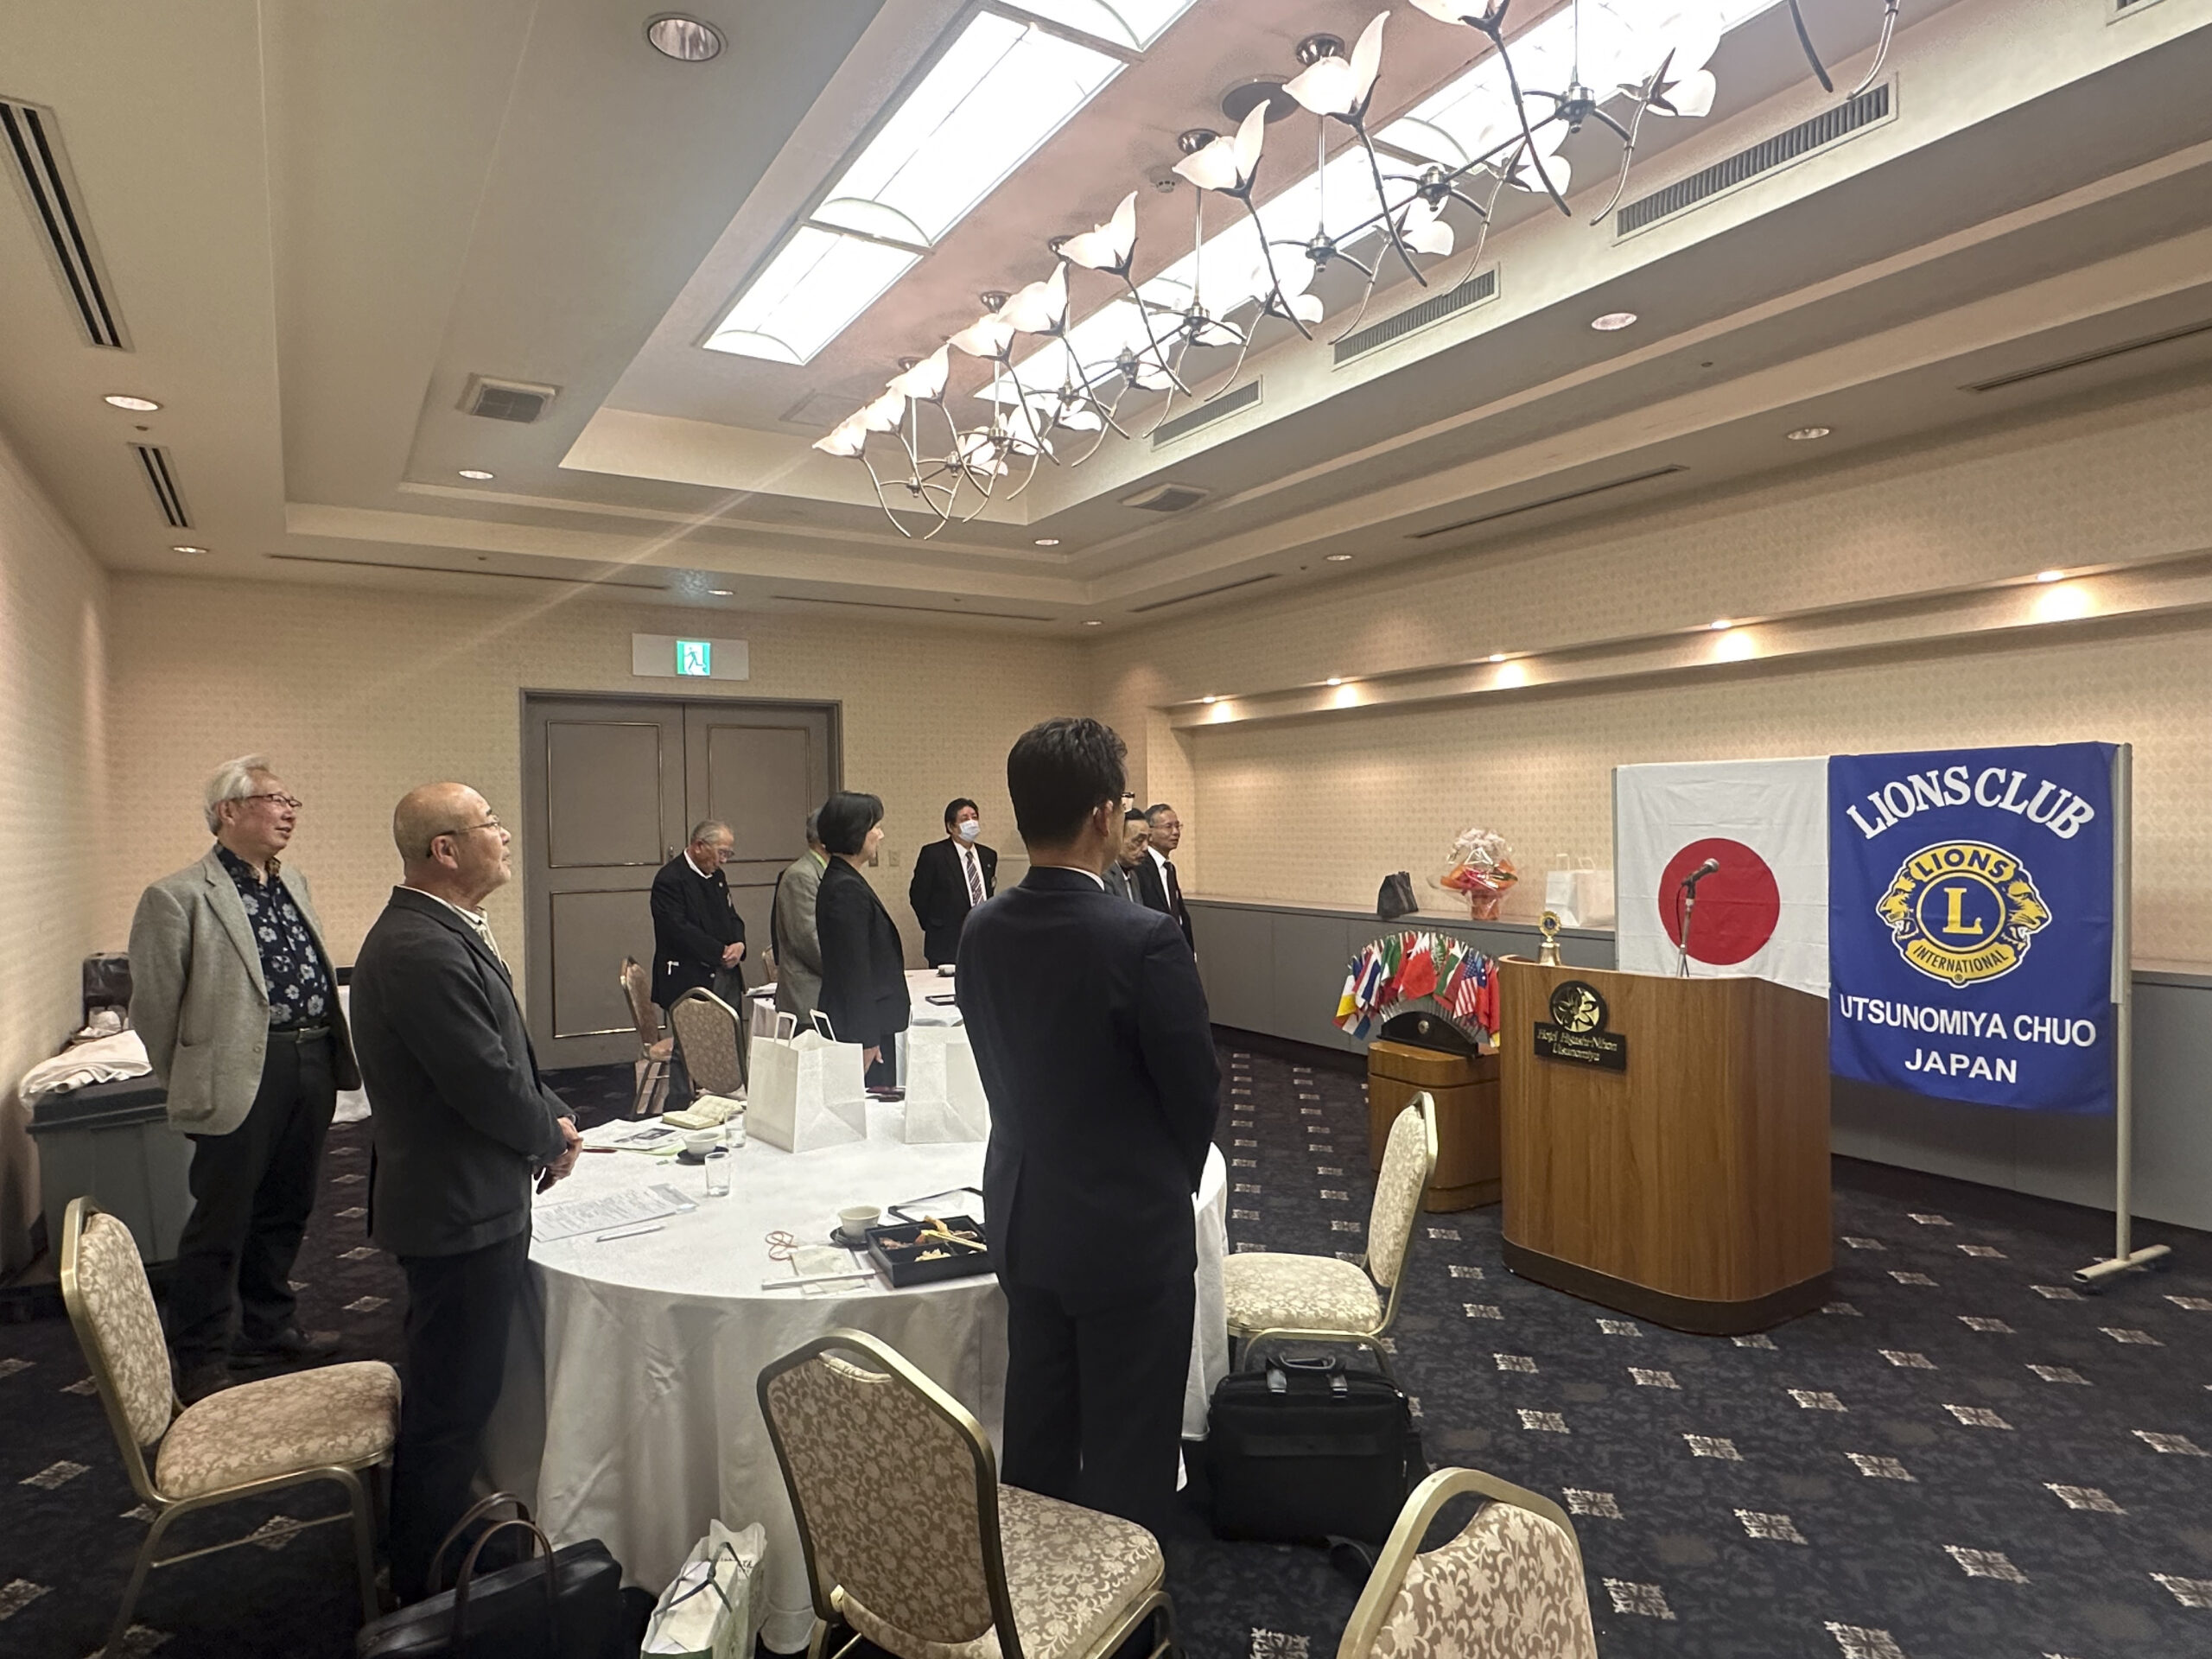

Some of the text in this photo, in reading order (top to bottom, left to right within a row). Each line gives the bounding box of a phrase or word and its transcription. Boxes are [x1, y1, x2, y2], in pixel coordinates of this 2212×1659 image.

[1847, 766, 2095, 840] LIONS CLUB
[1916, 849, 2011, 876] LIONS
[1942, 887, 1983, 935] L
[1913, 944, 2009, 974] INTERNATIONAL
[1840, 995, 2096, 1048] UTSUNOMIYA CHUO
[1904, 1049, 2017, 1084] JAPAN
